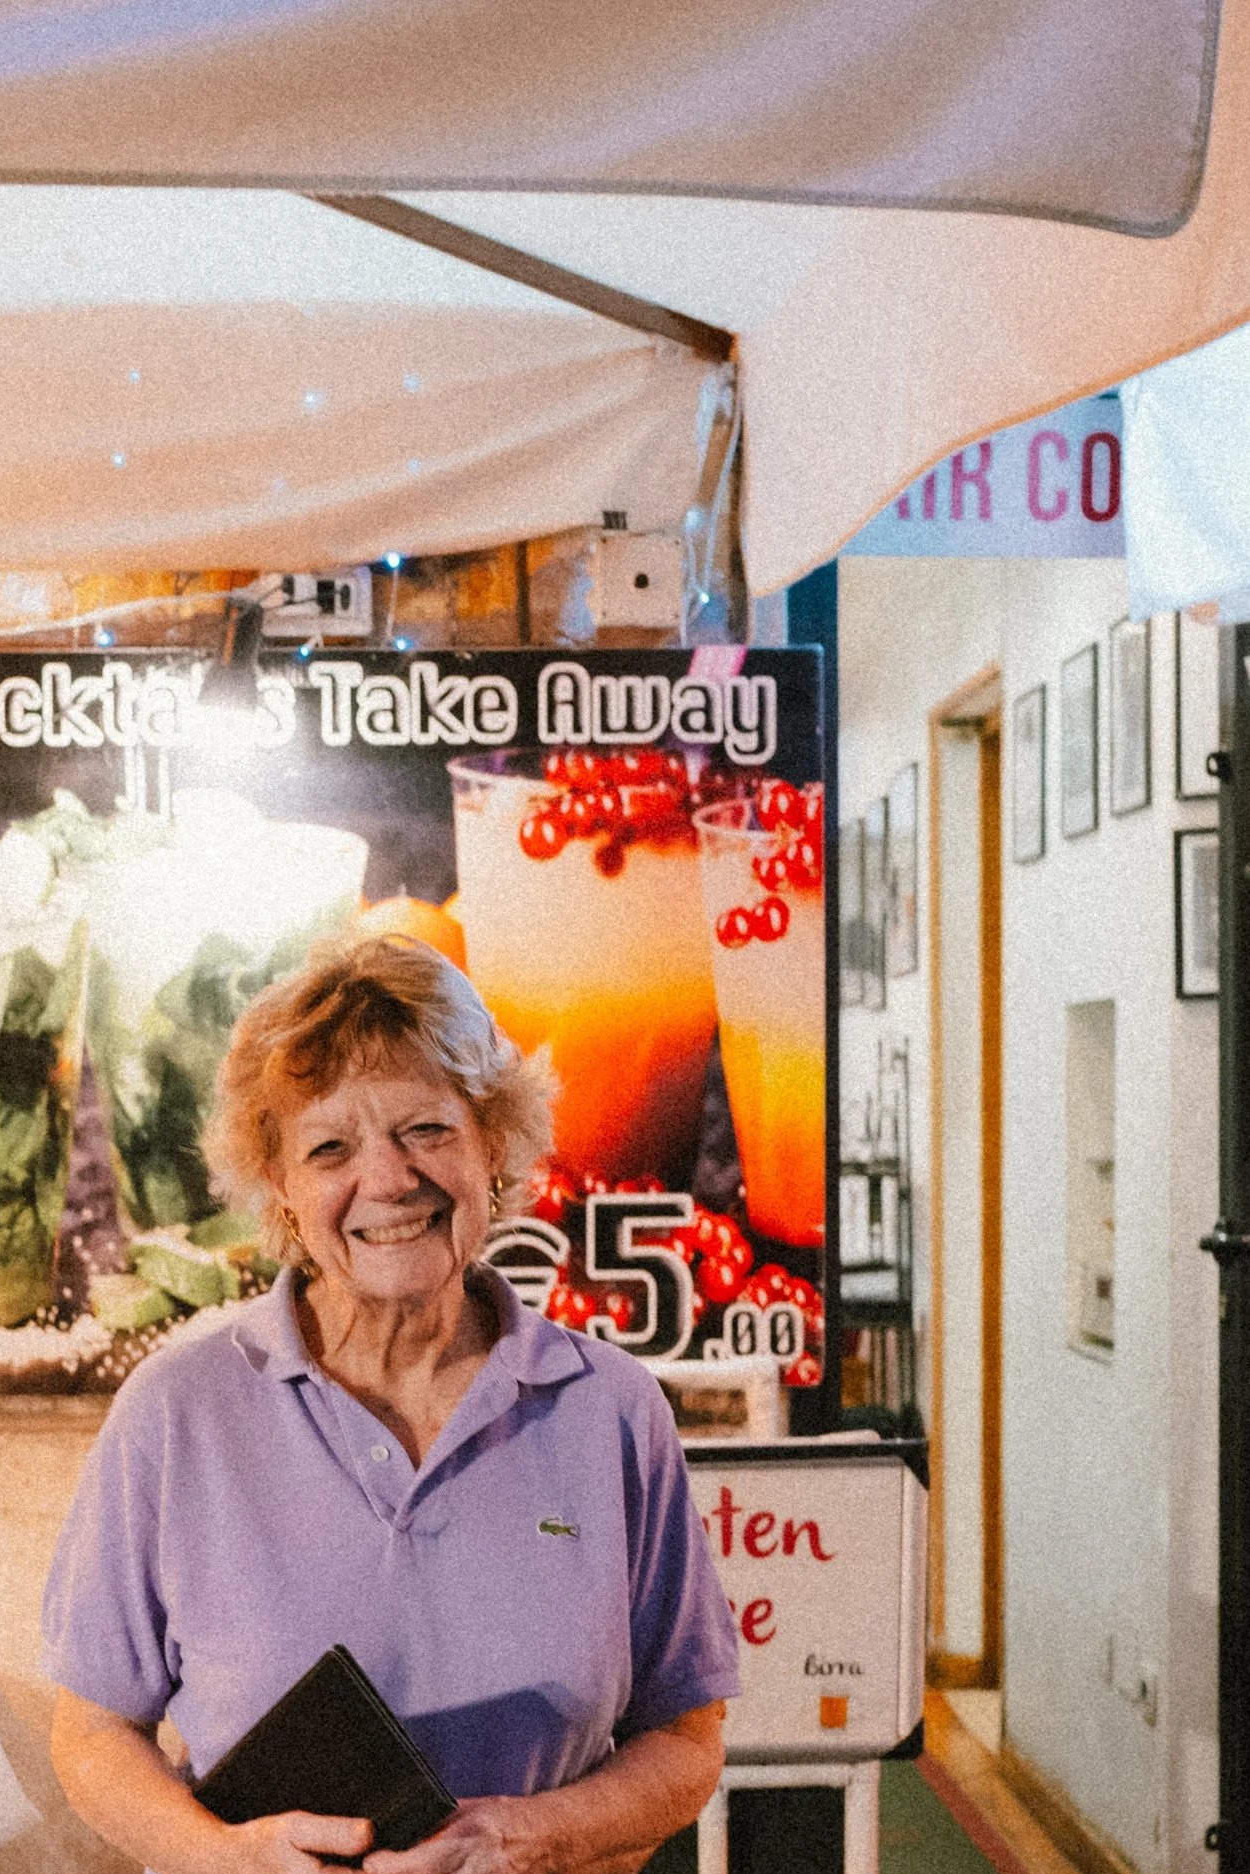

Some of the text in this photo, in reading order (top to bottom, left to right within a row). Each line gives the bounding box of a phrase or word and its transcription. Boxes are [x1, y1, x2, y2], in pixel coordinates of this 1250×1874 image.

[897, 431, 1121, 522] IR CO
[308, 661, 518, 747] Take
[537, 661, 777, 766] Away
[703, 1487, 835, 1561] ten
